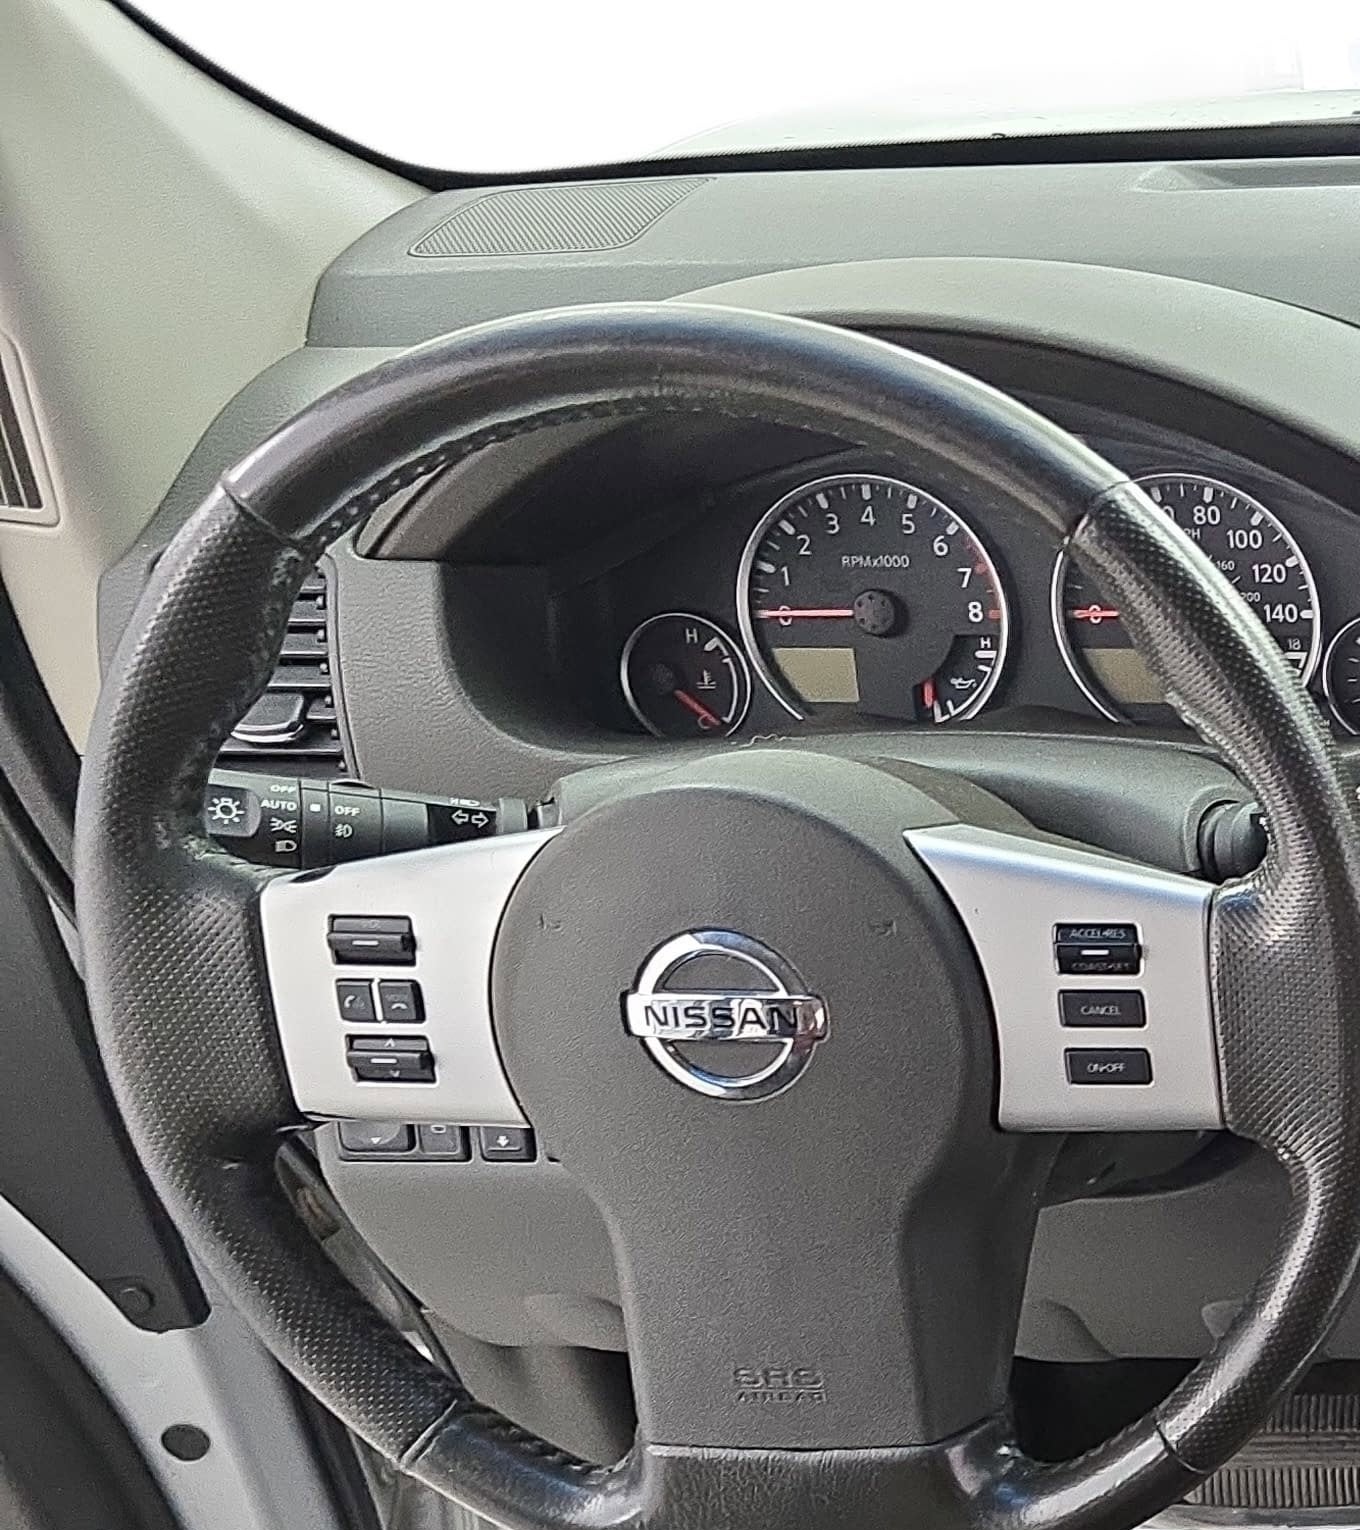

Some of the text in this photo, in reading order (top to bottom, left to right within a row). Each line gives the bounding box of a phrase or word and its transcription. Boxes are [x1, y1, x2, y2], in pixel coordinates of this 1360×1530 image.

[827, 515, 839, 534] 3
[861, 506, 875, 526] 4
[902, 515, 915, 533] 5
[1193, 506, 1221, 525] 80
[797, 535, 811, 555] 2
[933, 536, 948, 555] 6
[1227, 529, 1262, 549] 100
[841, 556, 909, 568] RPMx1000
[781, 569, 790, 585] 1
[958, 569, 972, 588] 7
[1252, 564, 1286, 583] 120
[968, 602, 983, 623] 8
[1264, 604, 1297, 622] 140
[686, 628, 698, 643] H
[980, 638, 991, 649] H
[270, 785, 296, 794] OFF
[260, 800, 297, 812] AUTO
[335, 806, 360, 816] OFF
[644, 1005, 798, 1033] NISSAN
[1080, 1005, 1121, 1015] CANCEL
